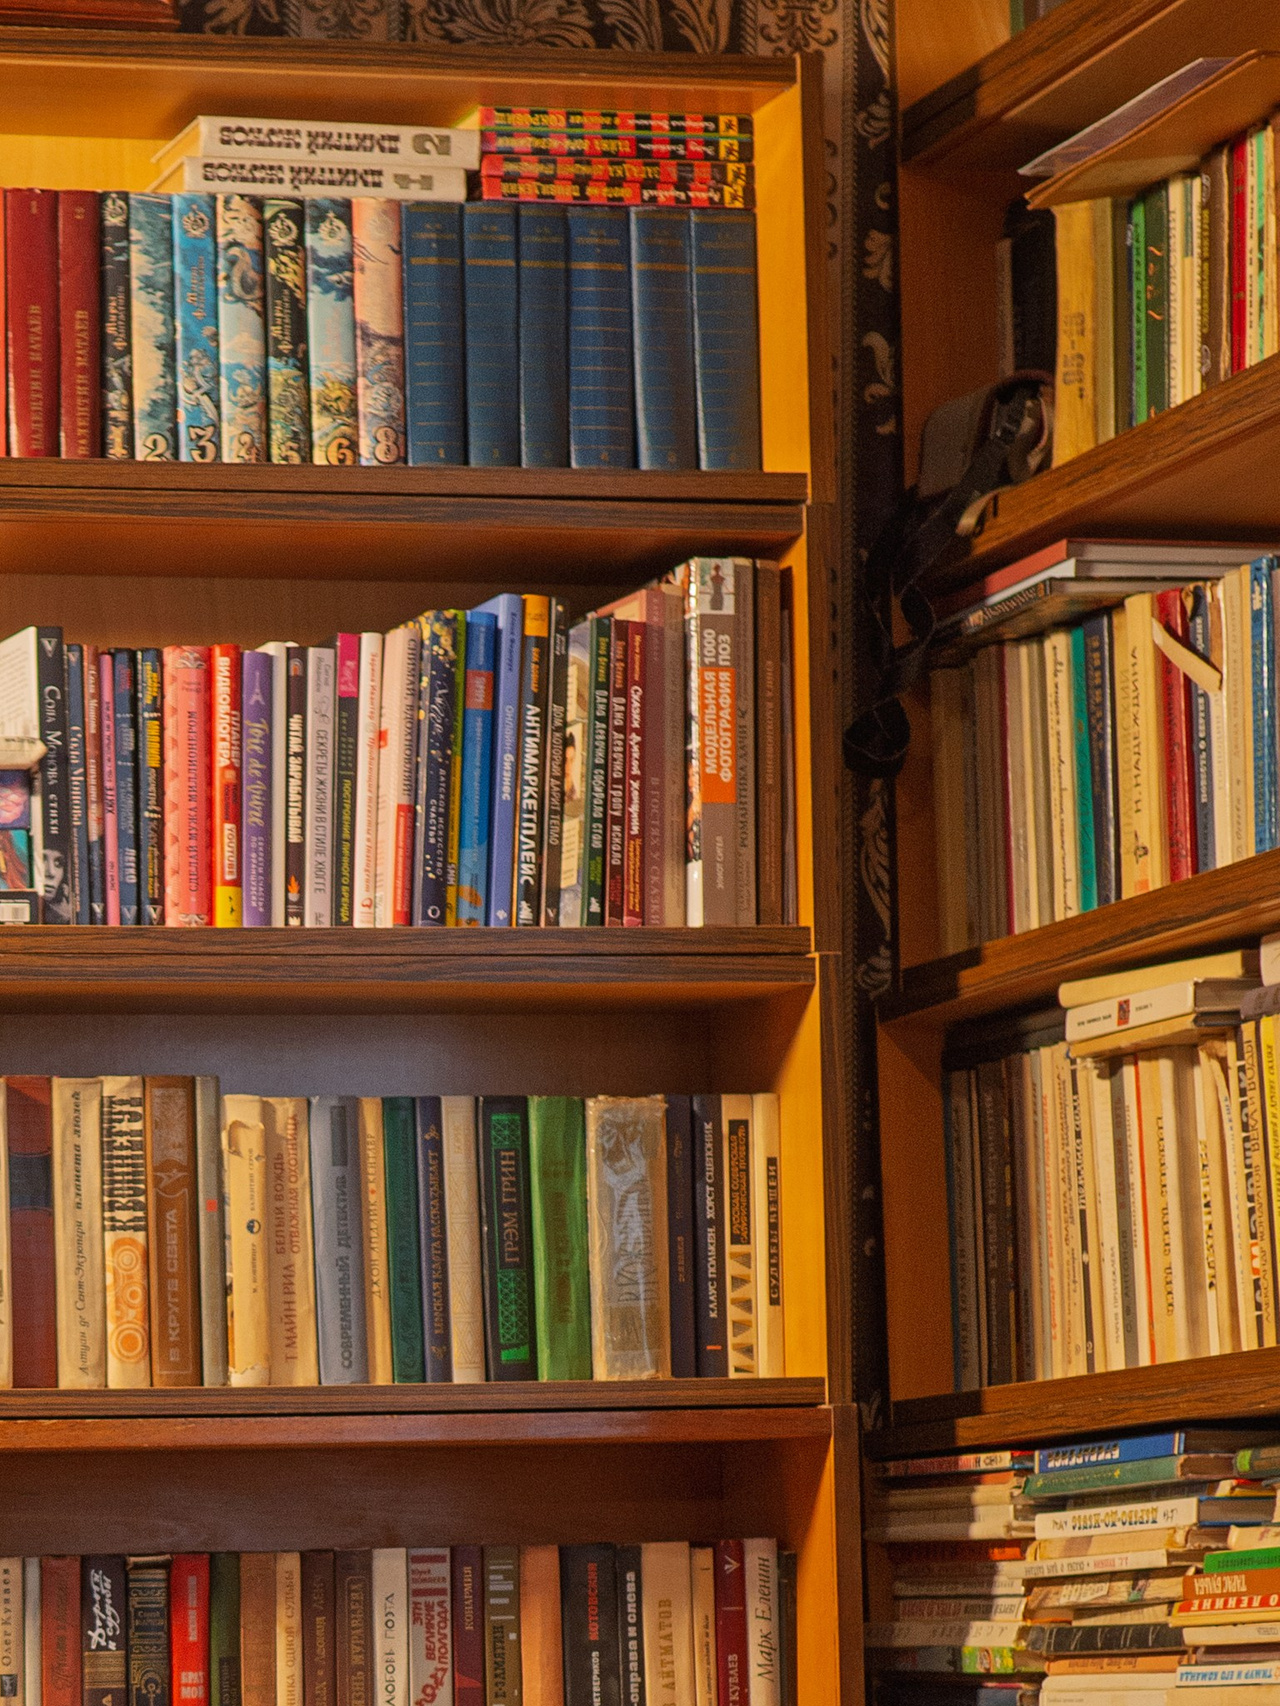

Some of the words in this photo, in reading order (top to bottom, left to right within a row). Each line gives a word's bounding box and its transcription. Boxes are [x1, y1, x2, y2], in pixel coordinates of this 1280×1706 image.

[412, 133, 451, 156] 2
[188, 427, 217, 462] 3
[327, 437, 351, 464] 6
[373, 428, 399, 463] 8
[404, 638, 418, 700] СНИМАЙ,
[703, 629, 717, 665] 1000
[717, 633, 731, 666] ПОЗ
[216, 656, 231, 768] ВИДЕОБЛОГЕРА
[703, 670, 718, 774] МОДЕЛЬНАЯ
[718, 670, 734, 783] ФОТОГРАФИЯ
[1130, 646, 1142, 784] НАДЕЖДИНА
[187, 710, 199, 802] МИЛЛИОНЕРОМ
[231, 711, 240, 768] ПЛАНЕР
[316, 729, 328, 775] СЕКРЕТЫ
[402, 704, 416, 797] ВДОХНОВЛЯЙ!
[287, 757, 304, 843] ЗАРАБАТЫВАЙ
[316, 778, 328, 814] ЖИЗНИ
[520, 704, 540, 885] АНТИМАРКЕТПЛЕЙС
[187, 807, 200, 841] МУЖА
[315, 825, 327, 857] СТИЛЕ
[187, 845, 200, 893] СДЕЛАЙ
[225, 826, 236, 878] YOUTUBE
[315, 860, 327, 895] ХЮГГЕ
[341, 886, 350, 922] БРЕНДА
[1243, 1039, 1258, 1092] ВОДЫ
[71, 1091, 82, 1138] людей
[286, 1113, 300, 1184] ОХОТНИЦА
[366, 1133, 378, 1184] КЕНТАВР
[71, 1143, 83, 1211] планета
[272, 1152, 285, 1202] ВОЖДЬ
[501, 1150, 517, 1204] ГРИН
[767, 1165, 779, 1223] ВЕЩЕЙ
[274, 1205, 286, 1255] БЕЛЫЙ
[288, 1187, 302, 1254] ОТВАЖНАЯ
[335, 1175, 352, 1249] ДЕТЕКТИВ
[367, 1199, 379, 1253] АПДАЙК
[504, 1211, 520, 1263] ГРЭМ
[73, 1221, 88, 1311] Сент-Экзюпери
[166, 1208, 178, 1272] СВЕТА
[768, 1229, 780, 1298] СУДЬБЫ
[283, 1265, 296, 1297] РИД
[369, 1258, 382, 1299] ДЖОН
[77, 1315, 91, 1328] де
[167, 1277, 180, 1341] КРУГЕ
[281, 1300, 298, 1351] МАЙН
[336, 1256, 354, 1369] СОВРЕМЕННЫЙ
[77, 1332, 90, 1375] Антуан
[169, 1349, 181, 1362] В
[87, 1569, 108, 1650] Дороги
[283, 1570, 294, 1619] СУДЬБЫ
[412, 1601, 423, 1627] ЭТИ
[462, 1566, 474, 1631] КОНАРМИЯ
[587, 1562, 600, 1641] КОТОВСКИЙ
[754, 1557, 771, 1622] Еленин
[1190, 1595, 1262, 1611] ЛЕНИНЕ
[1270, 1594, 1279, 1607] О
[284, 1626, 295, 1668] ОДНОЙ
[424, 1600, 437, 1661] ВЕЛИКИЕ
[437, 1599, 451, 1665] ПОЛГОДА
[658, 1598, 677, 1691] АЙТМАТОВ
[756, 1630, 777, 1682] Марк
[727, 1653, 740, 1701] КУВАЕВ
[1179, 1671, 1219, 1682] КОМАНДА
[1220, 1671, 1235, 1682] ЕГО
[1245, 1669, 1273, 1680] ТИМУР
